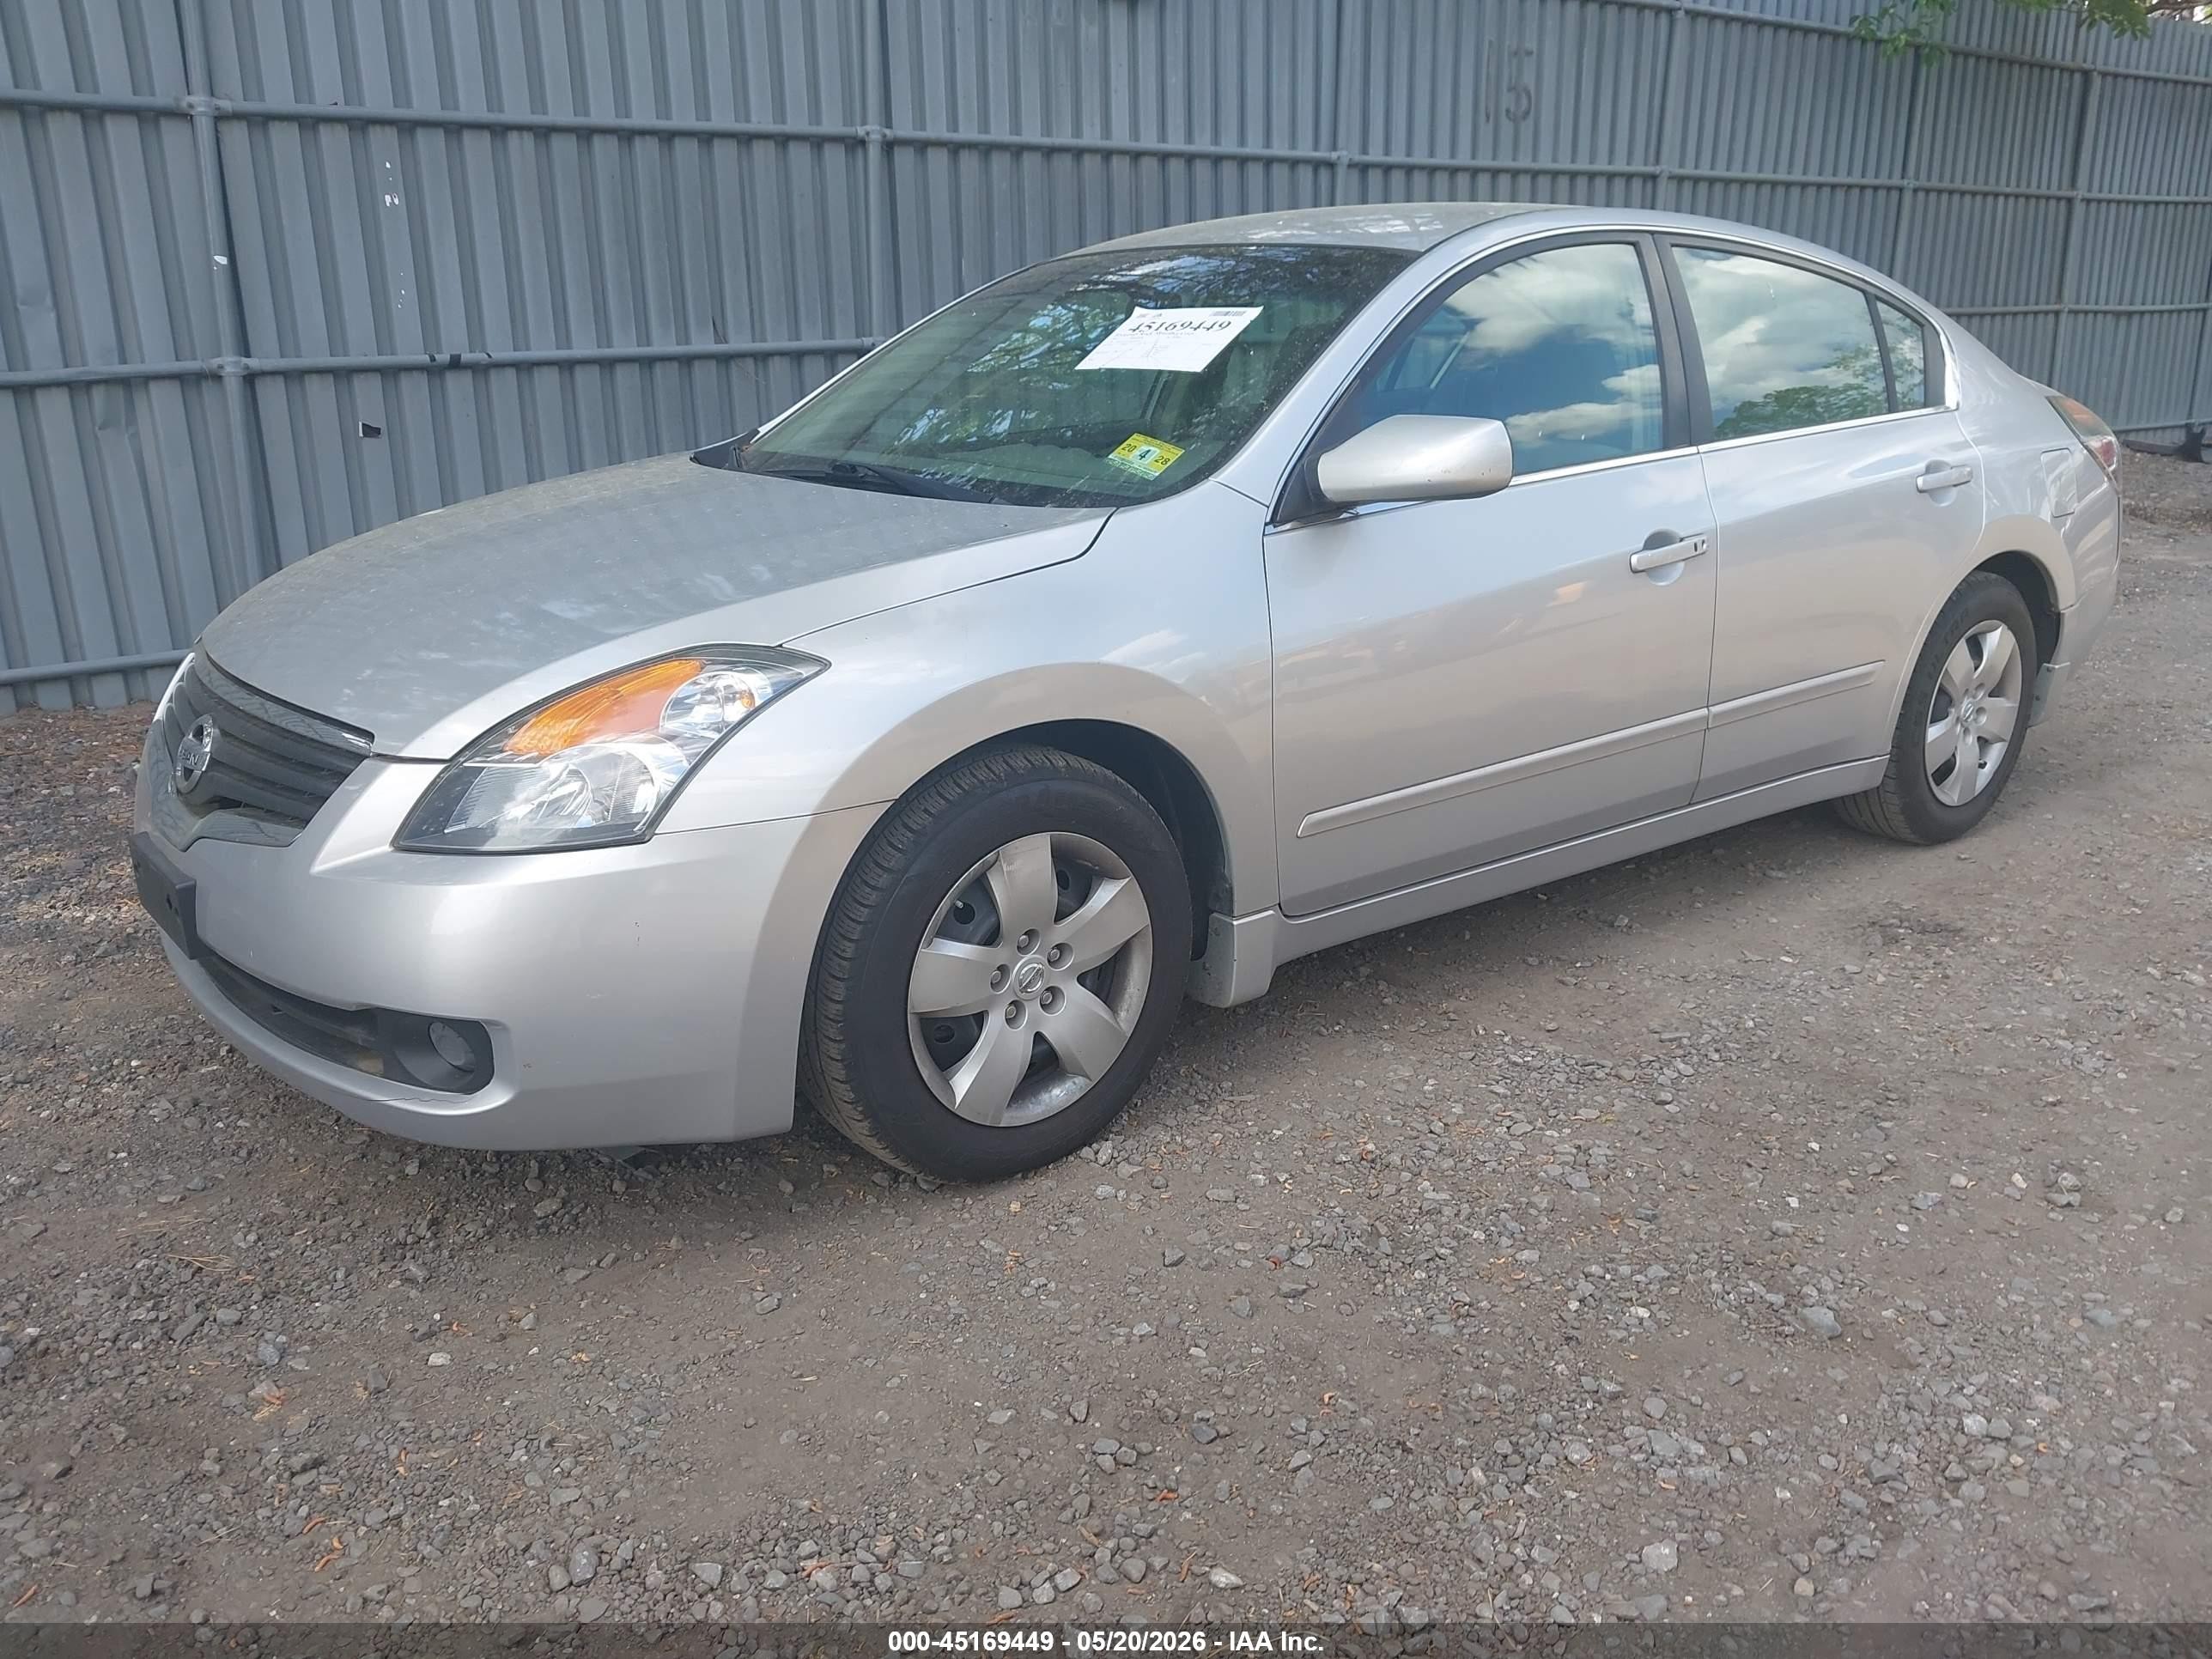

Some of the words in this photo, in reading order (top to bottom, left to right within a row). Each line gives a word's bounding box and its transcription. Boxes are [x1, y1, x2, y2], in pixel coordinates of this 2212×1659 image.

[1128, 320, 1231, 332] 45169449
[1121, 443, 1137, 453] 20
[1139, 448, 1152, 461] 4
[1154, 455, 1171, 465] 28
